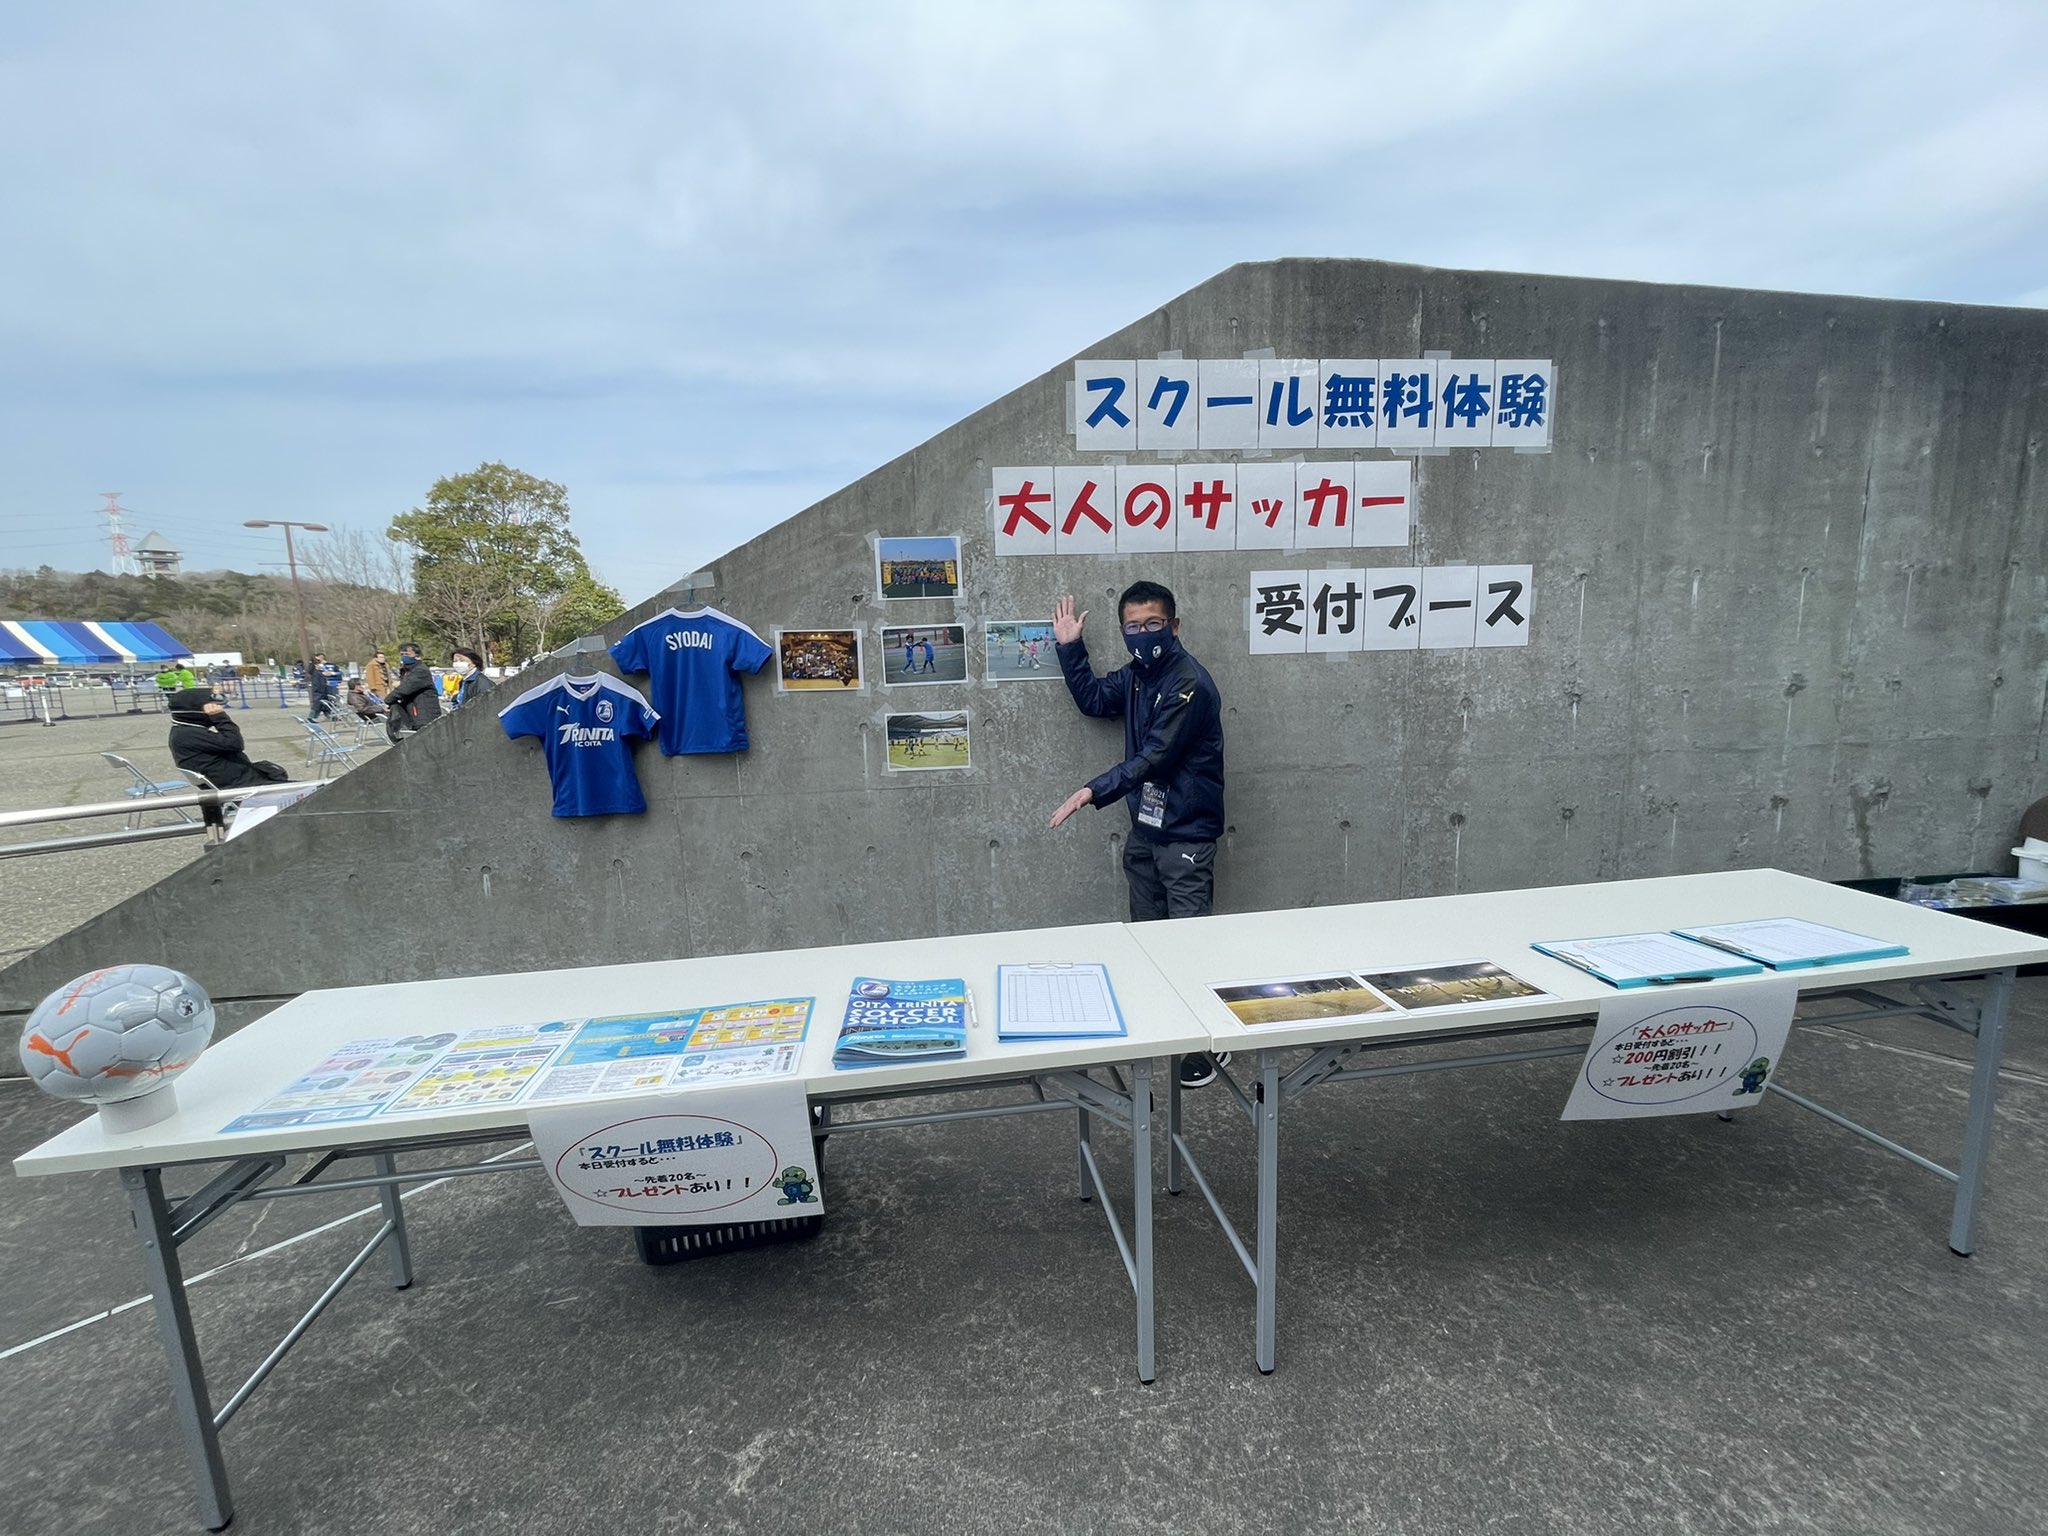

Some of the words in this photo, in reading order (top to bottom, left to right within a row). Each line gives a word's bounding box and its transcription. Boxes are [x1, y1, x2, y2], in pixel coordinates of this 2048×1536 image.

[1085, 372, 1549, 429] スクール無料体験
[998, 478, 1406, 537] 大人のサッカー
[1254, 580, 1526, 636] 受付ブース
[665, 630, 713, 651] SYODAI
[558, 722, 615, 745] TRINITA
[849, 1008, 958, 1018] SOCCER
[852, 1000, 891, 1009] OITA
[896, 1000, 958, 1009] TRINITA
[847, 1016, 960, 1026] SCHOOL
